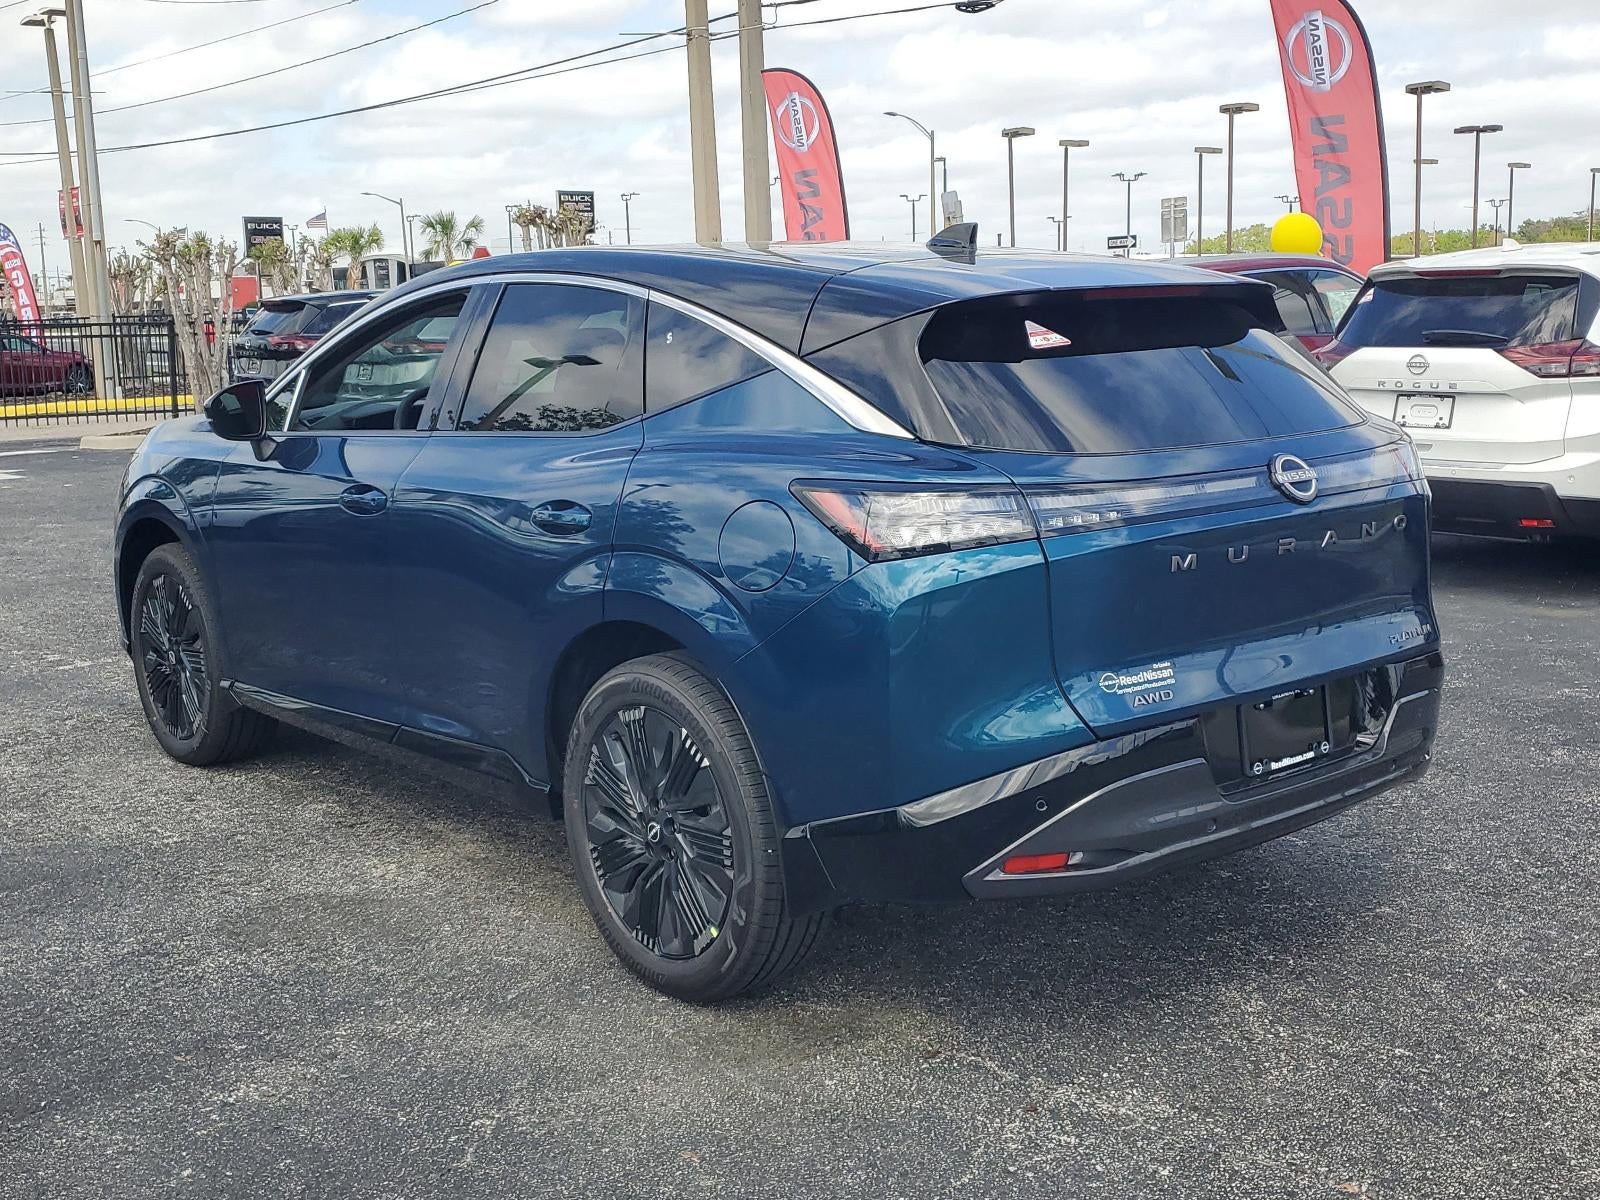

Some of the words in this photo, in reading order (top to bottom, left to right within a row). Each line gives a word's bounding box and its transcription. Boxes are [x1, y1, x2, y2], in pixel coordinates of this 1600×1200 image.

[561, 194, 592, 202] BUICK
[247, 222, 281, 230] BUICK
[1377, 380, 1458, 390] ROGUE
[1277, 467, 1318, 485] NISSAN
[1170, 514, 1408, 573] MURANO
[1133, 690, 1174, 708] AWD
